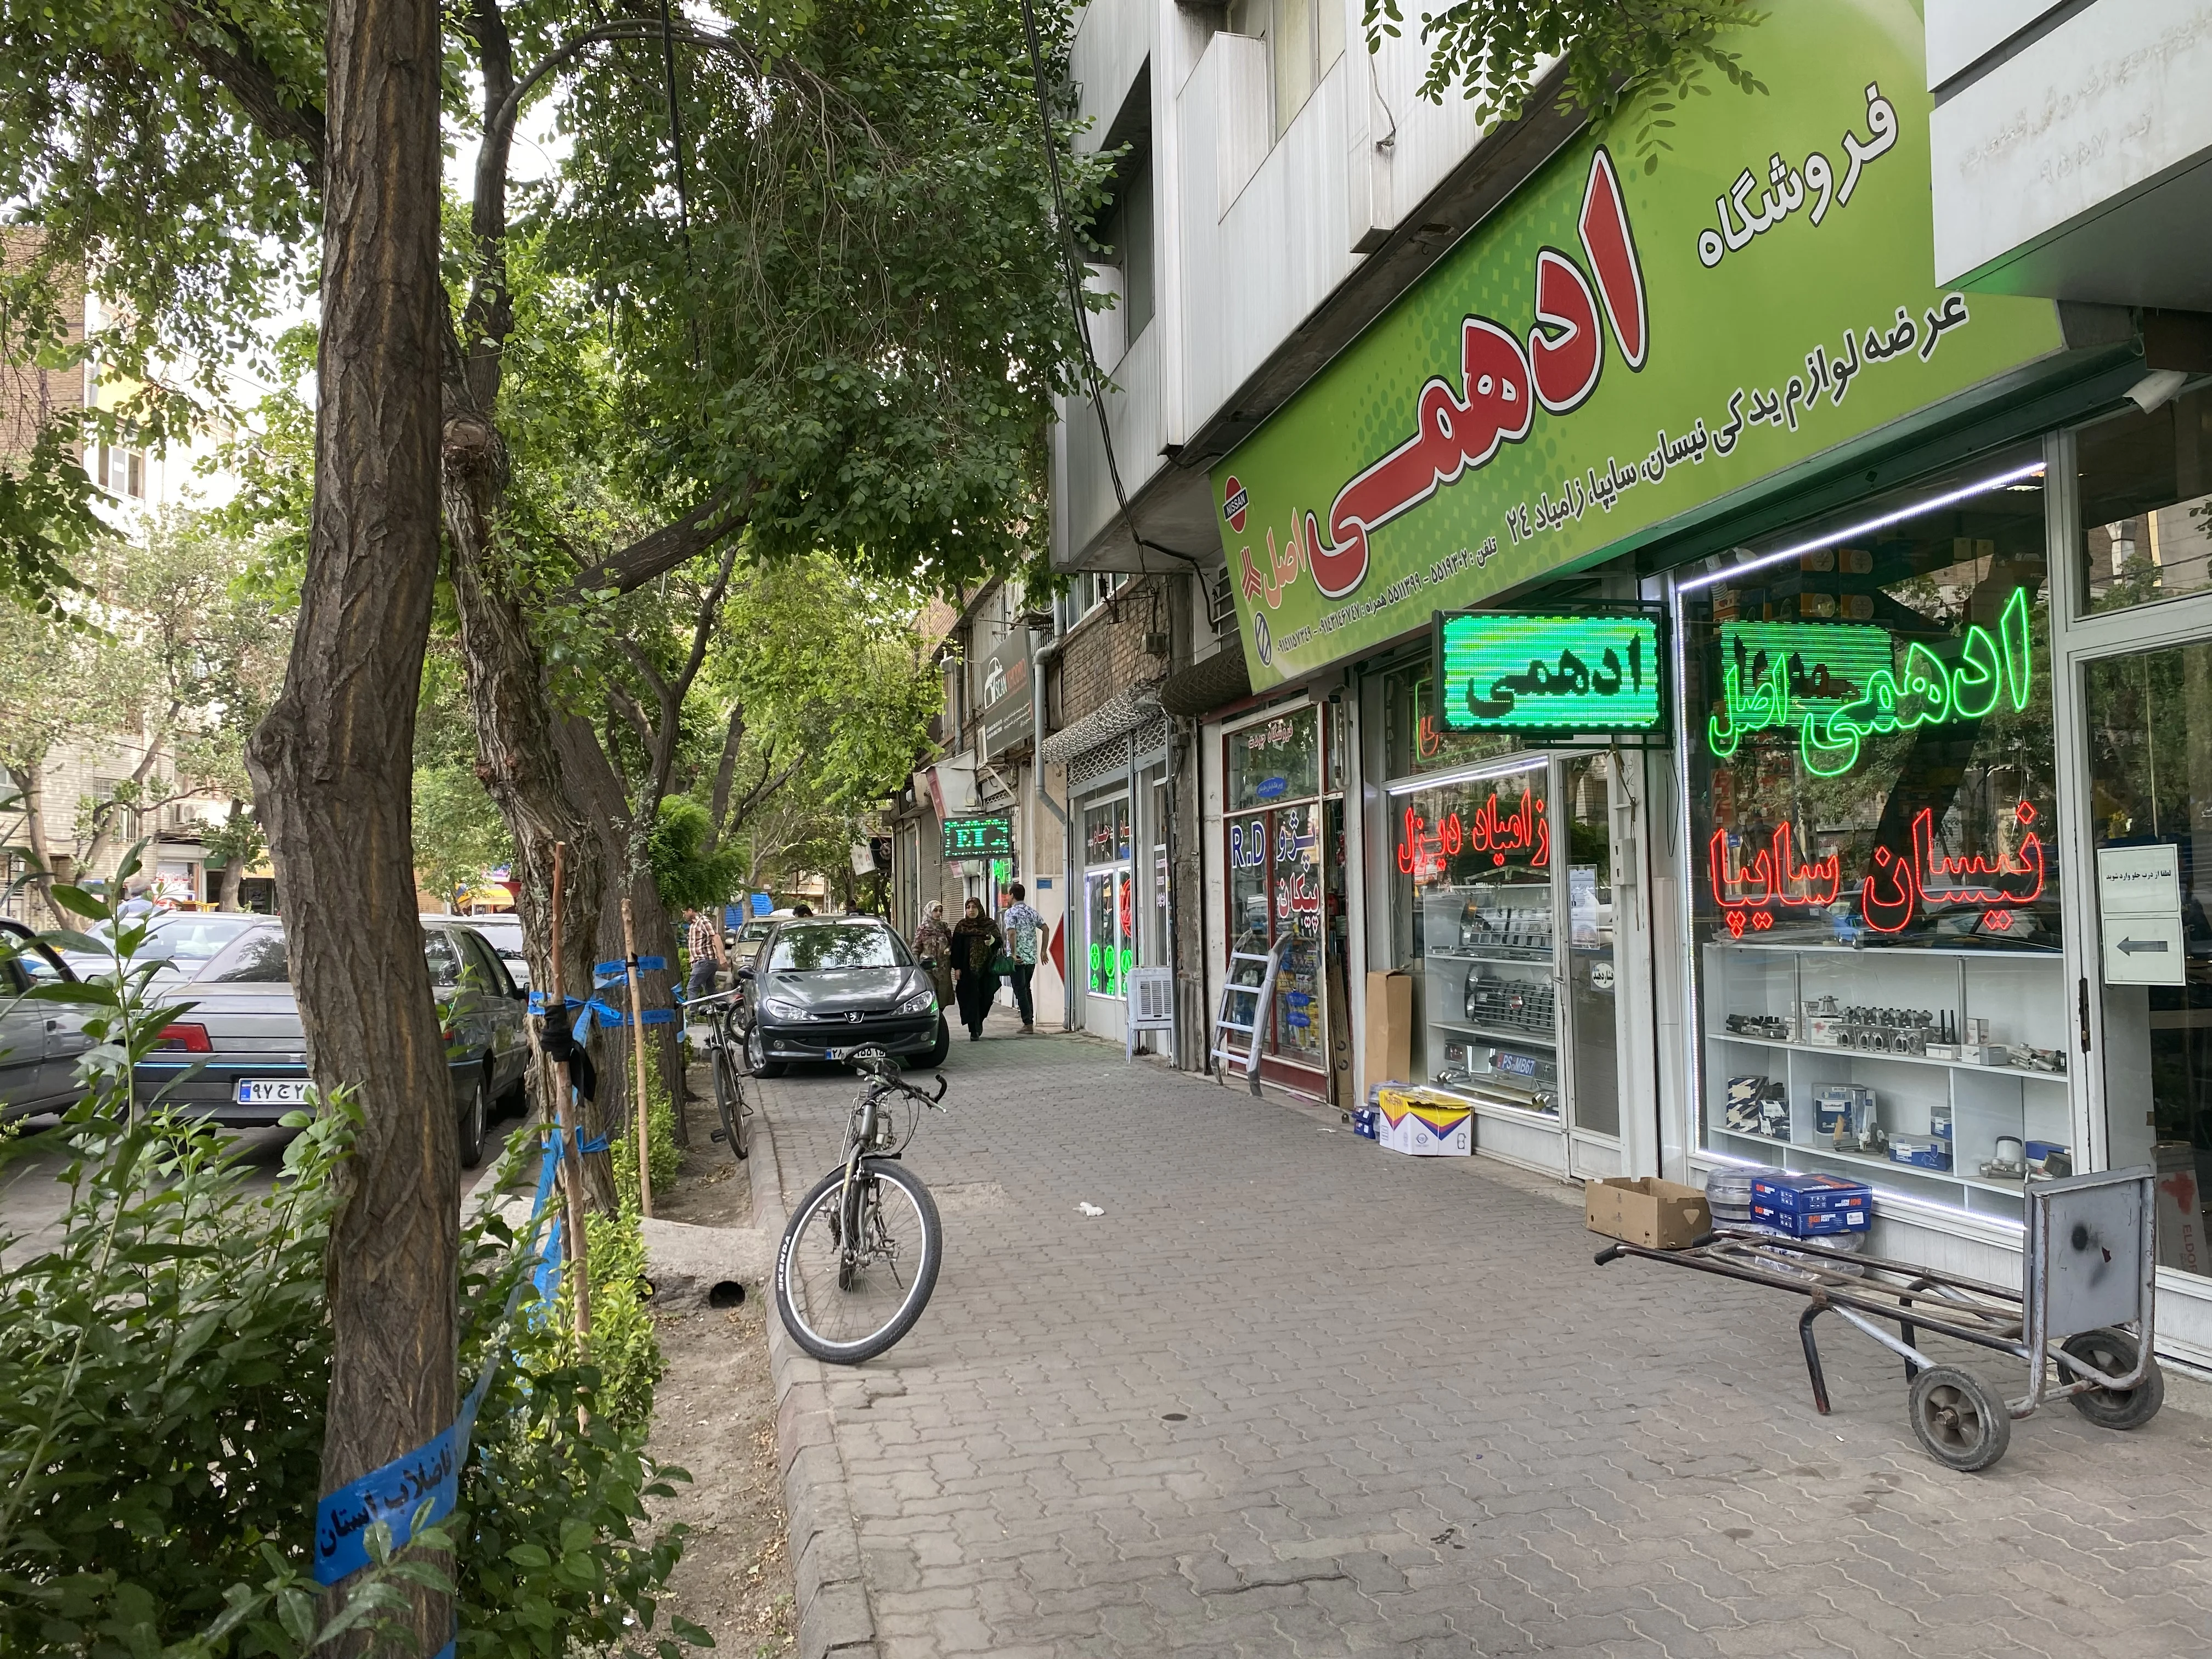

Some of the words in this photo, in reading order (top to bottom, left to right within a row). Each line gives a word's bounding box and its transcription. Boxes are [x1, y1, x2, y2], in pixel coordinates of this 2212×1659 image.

[1697, 81, 1900, 269] فروشگاه
[1864, 291, 1971, 363] عرضه
[1305, 144, 1649, 599] ادهمی
[1786, 330, 1861, 433] لوازم
[1712, 387, 1786, 458] یدکی
[1226, 493, 1245, 516] NISSAN
[1534, 482, 1585, 533] زامیاد
[1263, 507, 1306, 610] اصل
[1465, 631, 1641, 718] ادهمی
[1709, 652, 1787, 757] اصل
[1802, 586, 2030, 776] ادهمی
[1232, 821, 1266, 868] R.D
[1276, 809, 1316, 873] پژو
[1398, 806, 1462, 874] دیزل
[1472, 788, 1549, 866] زامیاد
[1278, 872, 1319, 934] پیکان
[1709, 821, 1839, 939] سایپا
[1863, 802, 2044, 932] نیسان
[778, 1236, 791, 1282] KENDA
